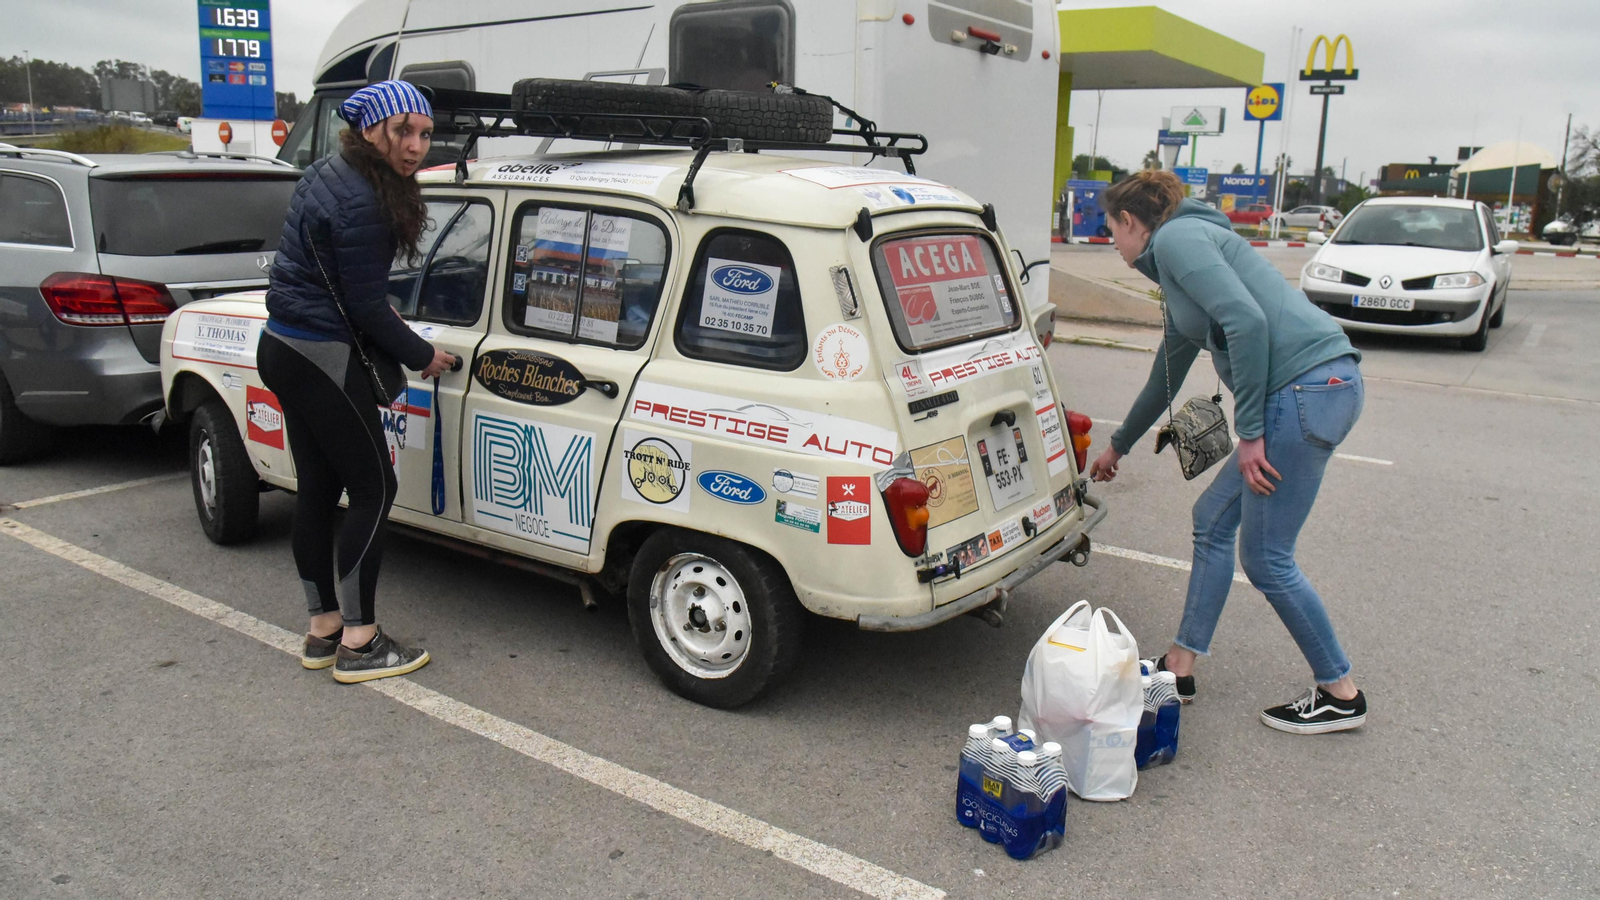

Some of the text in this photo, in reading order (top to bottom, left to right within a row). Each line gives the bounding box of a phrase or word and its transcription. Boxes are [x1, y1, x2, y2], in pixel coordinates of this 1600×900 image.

[217, 8, 259, 28] 1.639
[218, 38, 260, 58] 1.779
[492, 174, 550, 182] ASSURANCES
[498, 164, 560, 174] abeille
[601, 219, 626, 234] Dune
[899, 242, 976, 278] ACEGA
[723, 268, 761, 290] Ford
[722, 296, 743, 306] MATHIEU
[949, 294, 969, 304] François
[1360, 296, 1410, 309] 2860 GCC
[952, 304, 990, 315] Experts-Comptables
[198, 326, 247, 342] Y. THOMAS
[704, 316, 767, 334] 02 35 10 35 70
[507, 350, 554, 368] Saucissons
[478, 355, 580, 396] Roches Blanches
[902, 366, 918, 380] 4L
[928, 352, 1013, 386] PRESTIGE
[498, 383, 532, 400] Simplement
[633, 399, 894, 466] PRESTIGE AUTO
[624, 450, 654, 464] TROTT
[668, 459, 691, 471] RIDE
[1019, 448, 1024, 457] 27
[474, 415, 592, 528] BM
[995, 465, 1024, 489] 553-PX
[710, 474, 753, 501] Ford
[1033, 504, 1051, 519] Auchan
[515, 513, 550, 538] NEGOCE
[990, 535, 1003, 546] TAXI
